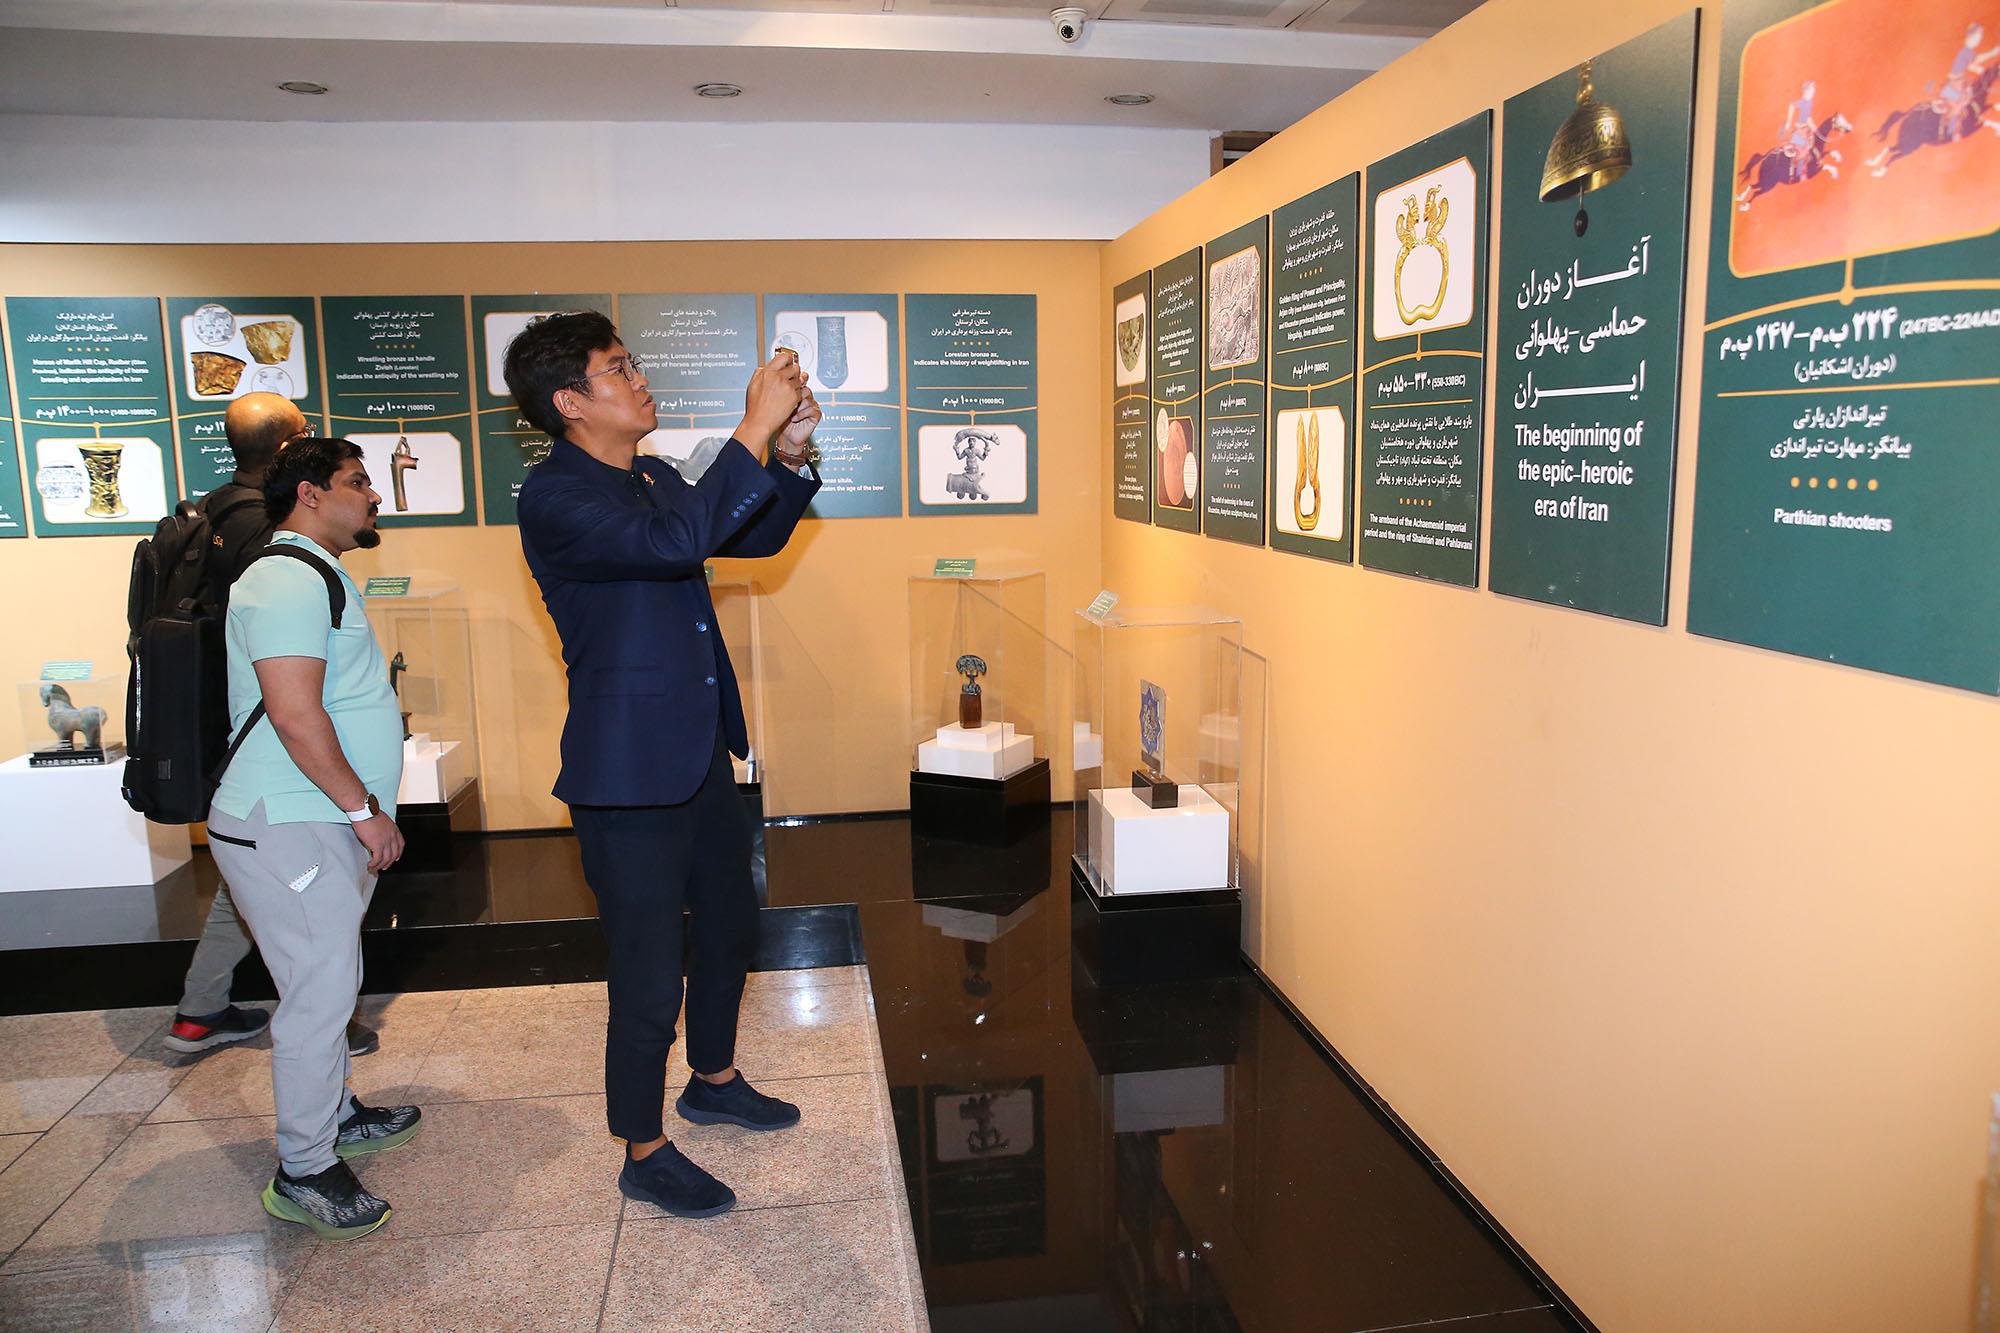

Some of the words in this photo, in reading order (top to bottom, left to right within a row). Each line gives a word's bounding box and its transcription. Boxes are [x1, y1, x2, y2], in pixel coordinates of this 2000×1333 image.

[1563, 234, 1651, 300] آغاز
[1516, 268, 1561, 310] دوران
[1719, 334, 1754, 360] پ.م
[950, 359, 970, 367] history
[1377, 381, 1393, 399] پ.م
[1513, 359, 1646, 410] ایران
[1793, 406, 1826, 430] پارتی
[1825, 404, 1888, 429] تیراندازان
[1515, 424, 1541, 447] The
[1543, 421, 1621, 453] beginning
[1623, 420, 1644, 447] of
[1770, 437, 1824, 459] تیراندازی
[1823, 436, 1865, 459] مهارت
[1867, 434, 1913, 460] بیانگر:
[1518, 458, 1540, 481] the
[1542, 459, 1634, 488] epic-heroic
[1534, 497, 1558, 519] era
[1560, 495, 1577, 519] of
[1578, 496, 1609, 522] Iran
[1773, 508, 1827, 527] Parthian
[1828, 512, 1893, 532] shooters
[1370, 513, 1378, 523] The
[1379, 515, 1399, 526] armband
[1399, 517, 1404, 526] of
[1404, 517, 1412, 527] the
[1412, 517, 1444, 530] Achaemenid
[1444, 520, 1467, 534] imperial
[1364, 528, 1379, 538] period
[1379, 529, 1388, 539] and
[1388, 530, 1396, 540] the
[1396, 531, 1406, 544] ring
[1406, 532, 1412, 542] of
[1435, 536, 1446, 547] and
[1445, 537, 1473, 550] Pahlavani
